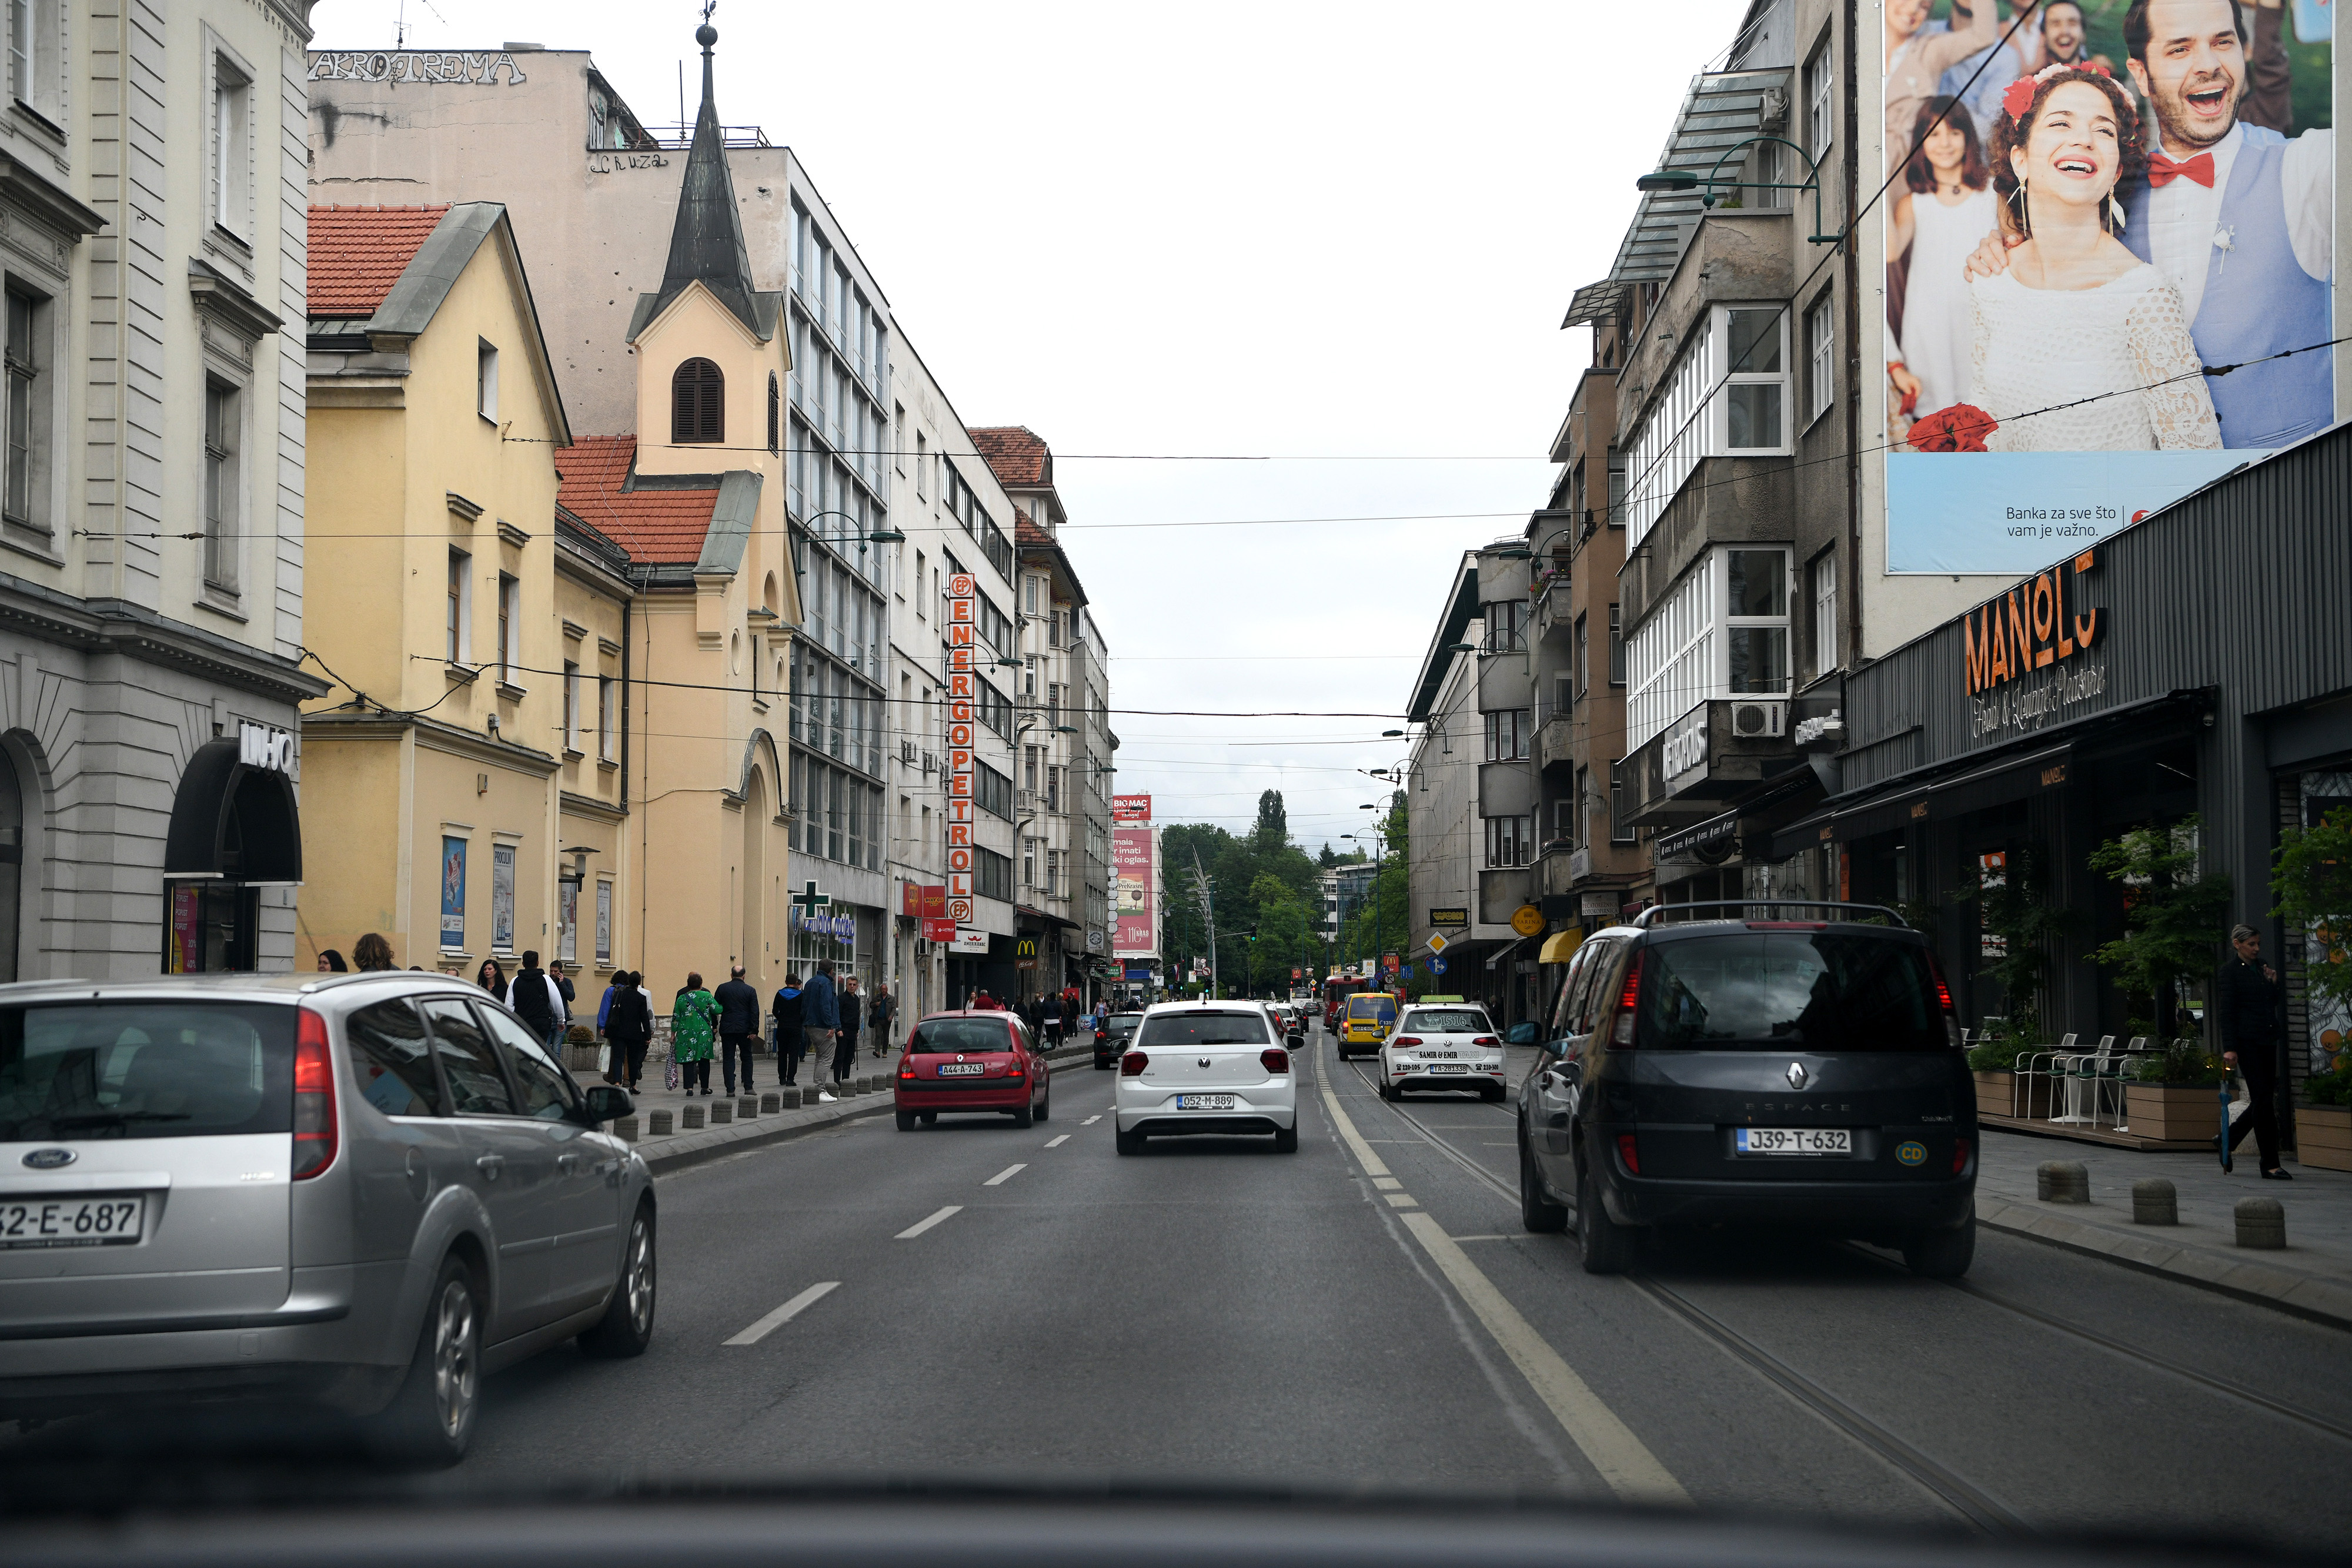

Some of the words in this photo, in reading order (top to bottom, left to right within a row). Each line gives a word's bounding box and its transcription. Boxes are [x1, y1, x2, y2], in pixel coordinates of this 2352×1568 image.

[2007, 507, 2046, 519] Banka
[2051, 509, 2065, 519] za
[2070, 509, 2092, 519] sve
[2096, 506, 2116, 519] što
[2007, 527, 2036, 536] vam
[2040, 525, 2052, 539] je
[2056, 523, 2099, 536] važno.
[1965, 550, 2097, 697] MANOLO
[951, 601, 970, 895] ENERGOPETROL
[1124, 856, 1149, 865] oglas.
[176, 894, 188, 902] POPUST
[175, 908, 188, 917] POPUST
[954, 904, 967, 917] EP
[175, 922, 188, 931] POPUST
[1439, 1015, 1466, 1027] 1516
[1458, 1051, 1479, 1059] TAXI
[943, 1065, 982, 1074] A44-A-743
[1745, 1103, 1852, 1112] ESPACE
[1751, 1131, 1847, 1150] J39-T-632
[1901, 1147, 1922, 1159] CD
[0, 1203, 135, 1235] 2-E-687
